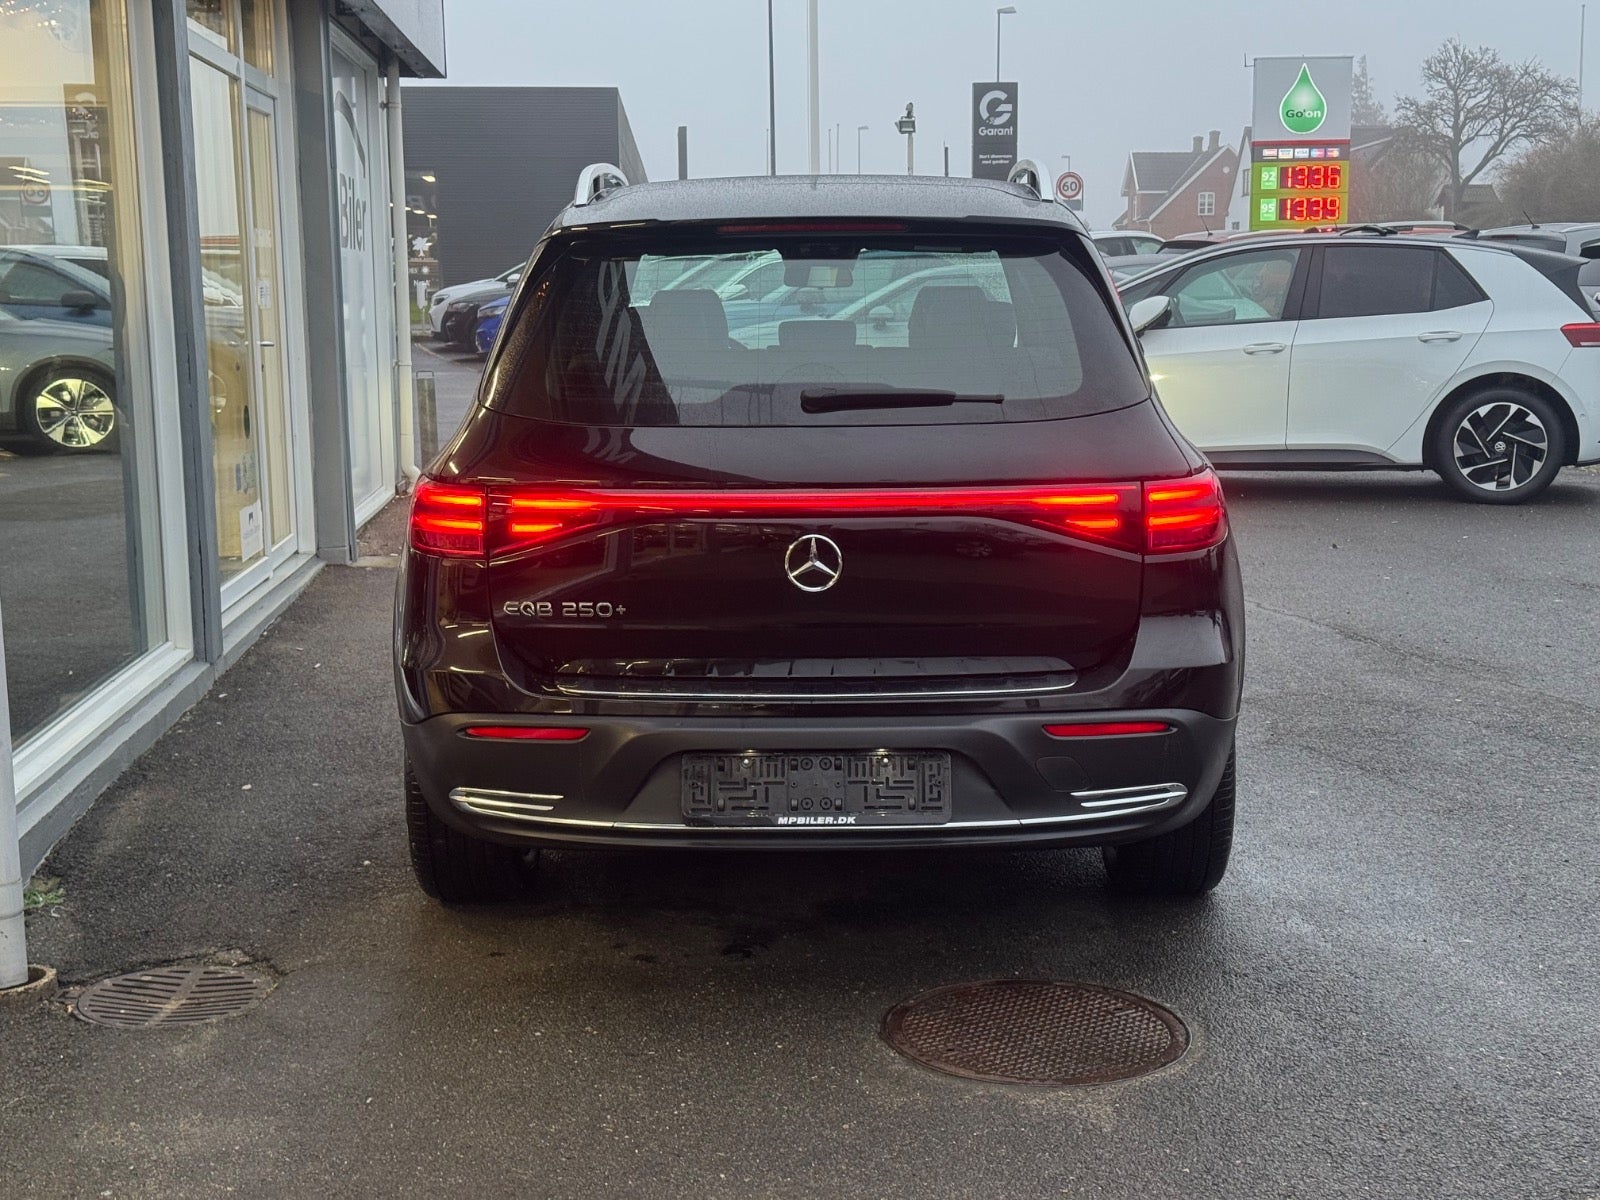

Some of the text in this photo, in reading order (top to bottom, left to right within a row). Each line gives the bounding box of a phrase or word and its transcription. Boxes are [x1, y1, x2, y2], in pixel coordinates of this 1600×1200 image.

[978, 126, 1013, 136] Garant
[1062, 181, 1078, 192] 60
[339, 172, 367, 253] Biler
[1262, 203, 1275, 213] 95
[1286, 197, 1340, 221] 13.39
[503, 601, 627, 617] EQB 250+
[777, 816, 856, 825] MPBILER.DK
